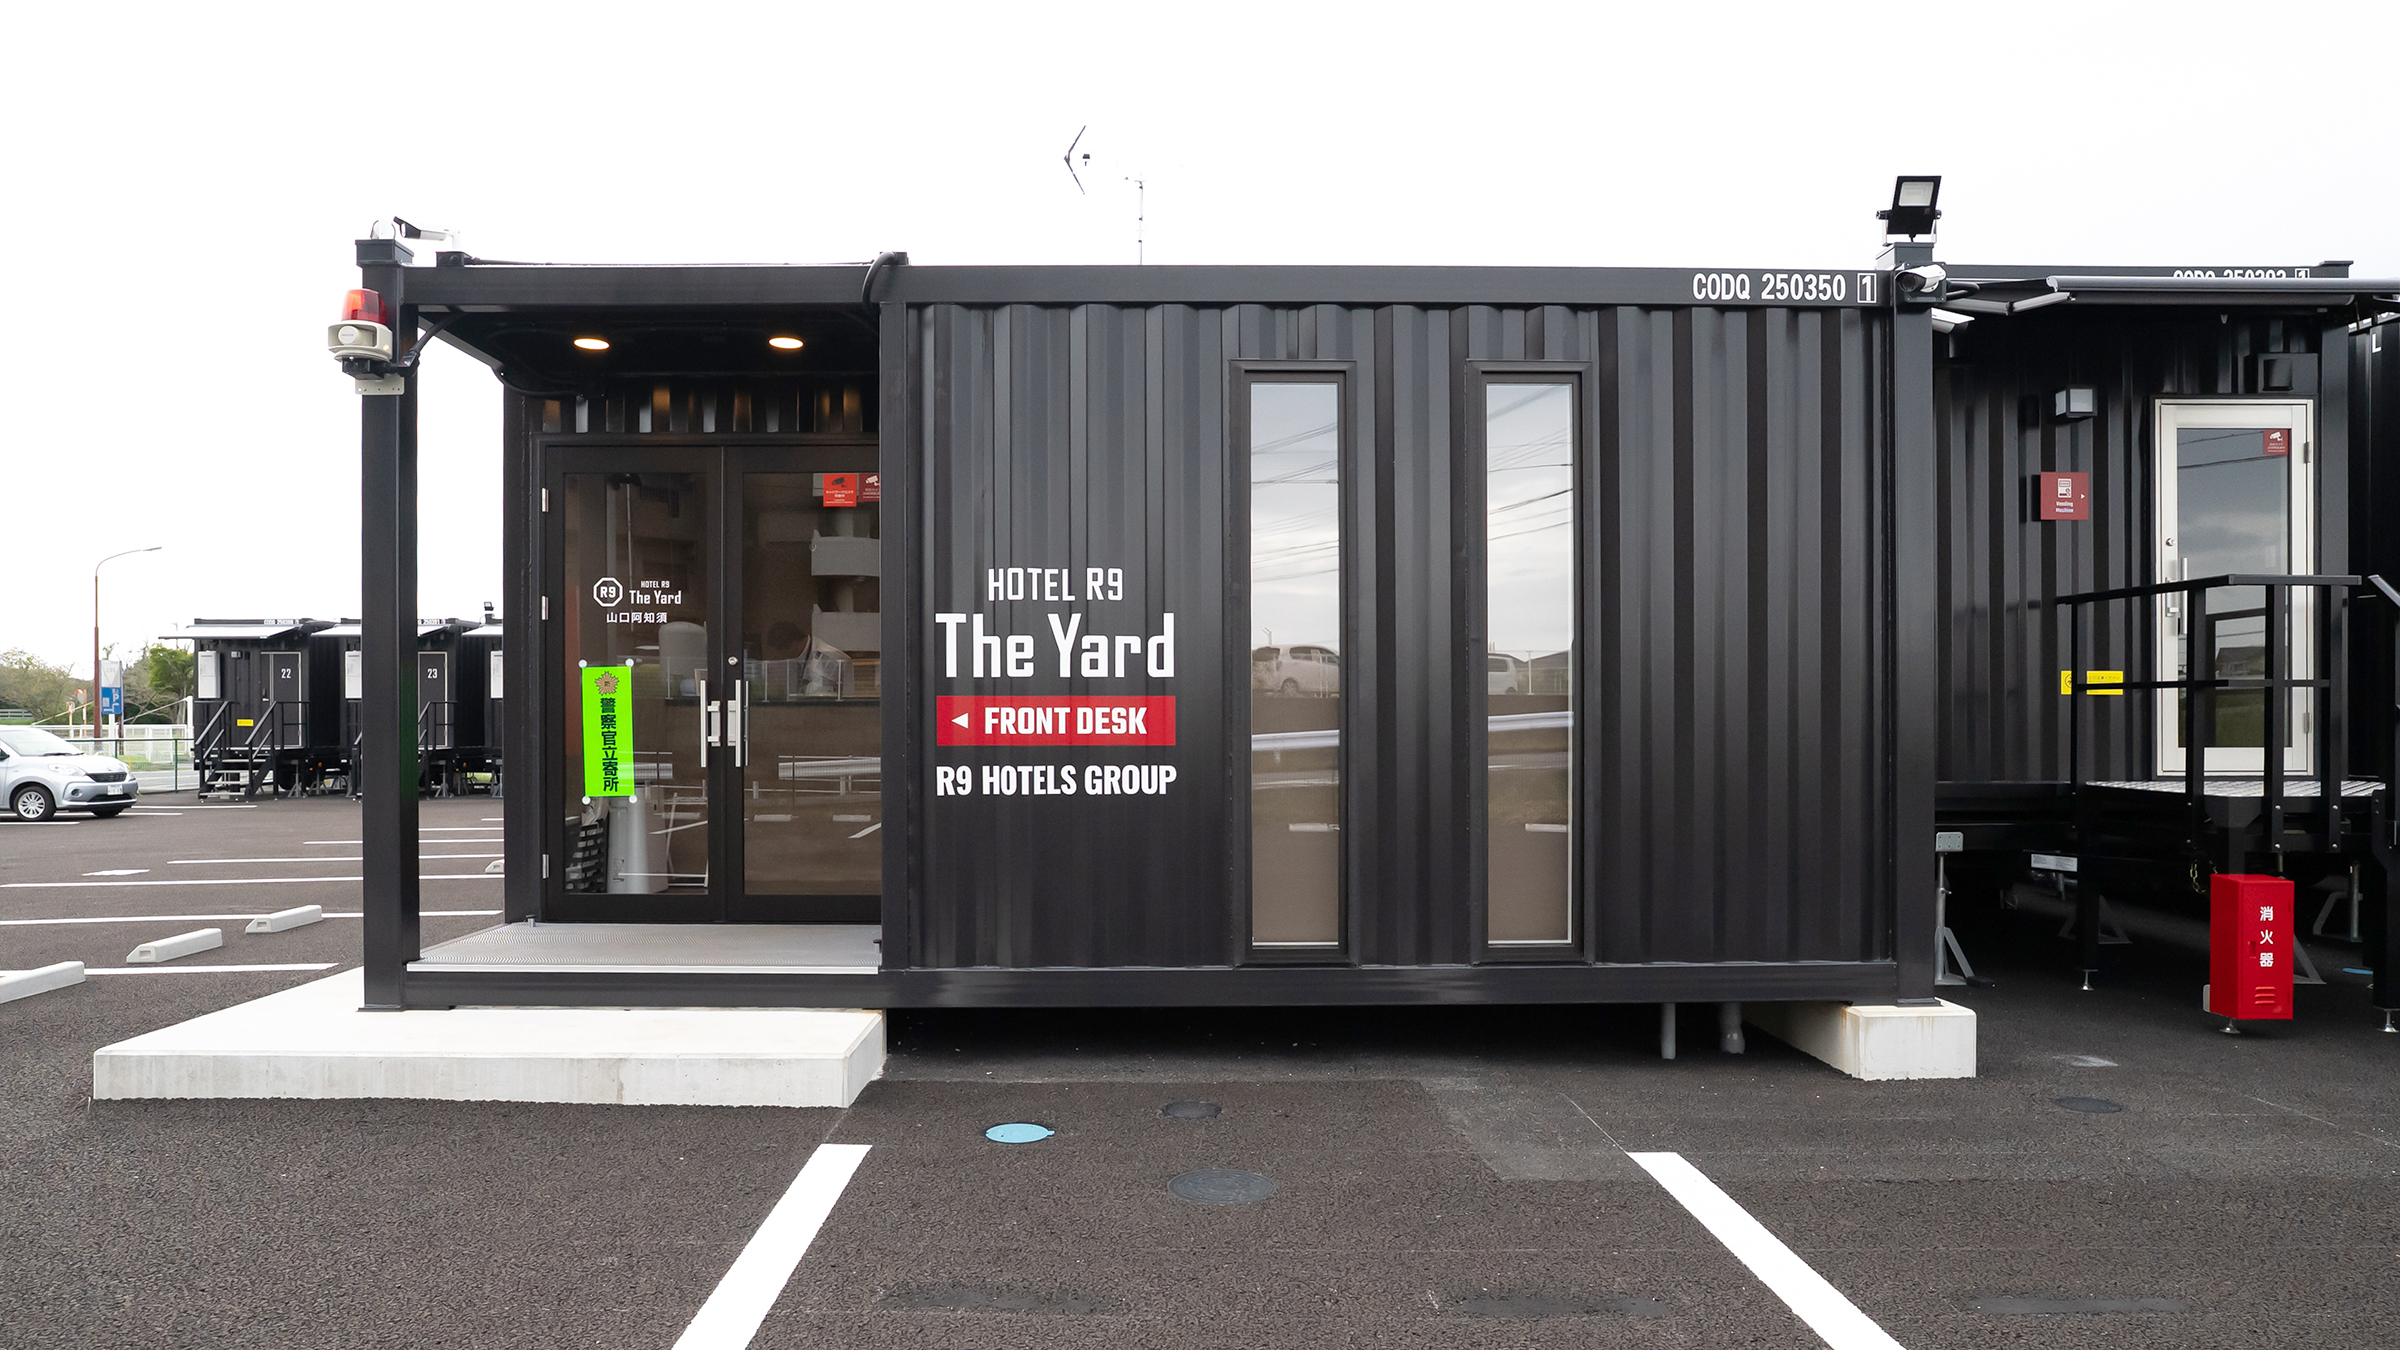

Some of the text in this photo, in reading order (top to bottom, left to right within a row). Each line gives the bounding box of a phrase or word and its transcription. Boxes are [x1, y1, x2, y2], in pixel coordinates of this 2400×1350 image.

[1693, 273, 1751, 300] CODQ
[1761, 273, 1847, 301] 250350
[600, 586, 616, 598] R9
[629, 590, 682, 604] The Yard
[988, 567, 1123, 601] HOTEL R9
[606, 612, 668, 623] 山口阿知須
[935, 613, 1175, 678] The Yard
[281, 668, 291, 679] 22
[428, 668, 438, 679] 23
[984, 707, 1148, 734] FRONT DESK
[600, 697, 619, 792] 警察官立寄所
[936, 764, 1177, 796] R9 HOTELS GROUP
[2259, 905, 2274, 967] 消火器
